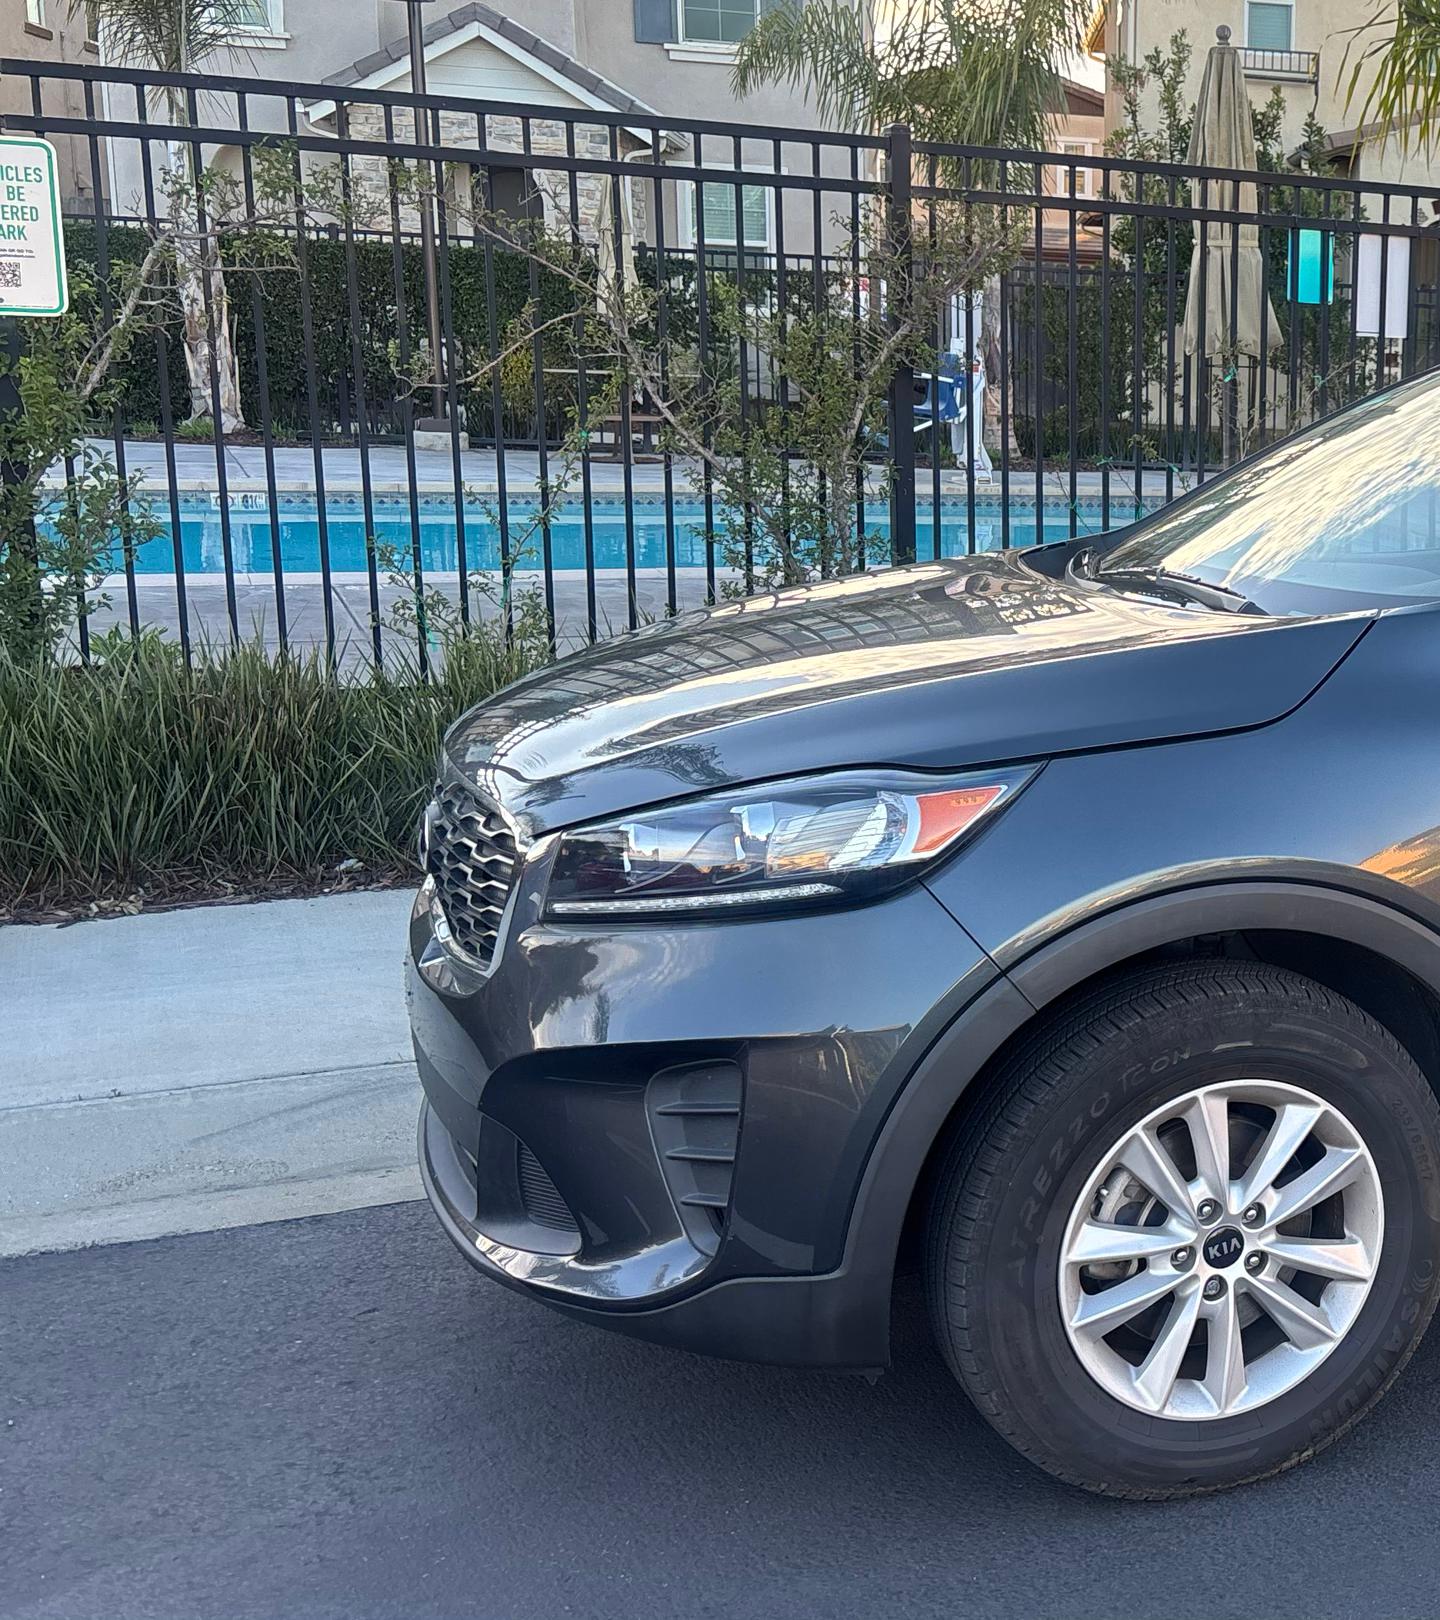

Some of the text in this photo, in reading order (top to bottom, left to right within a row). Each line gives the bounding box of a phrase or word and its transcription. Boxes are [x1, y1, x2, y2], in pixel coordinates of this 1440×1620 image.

[6, 185, 26, 202] BE
[1, 204, 39, 222] ERED
[1208, 1237, 1241, 1260] KIA
